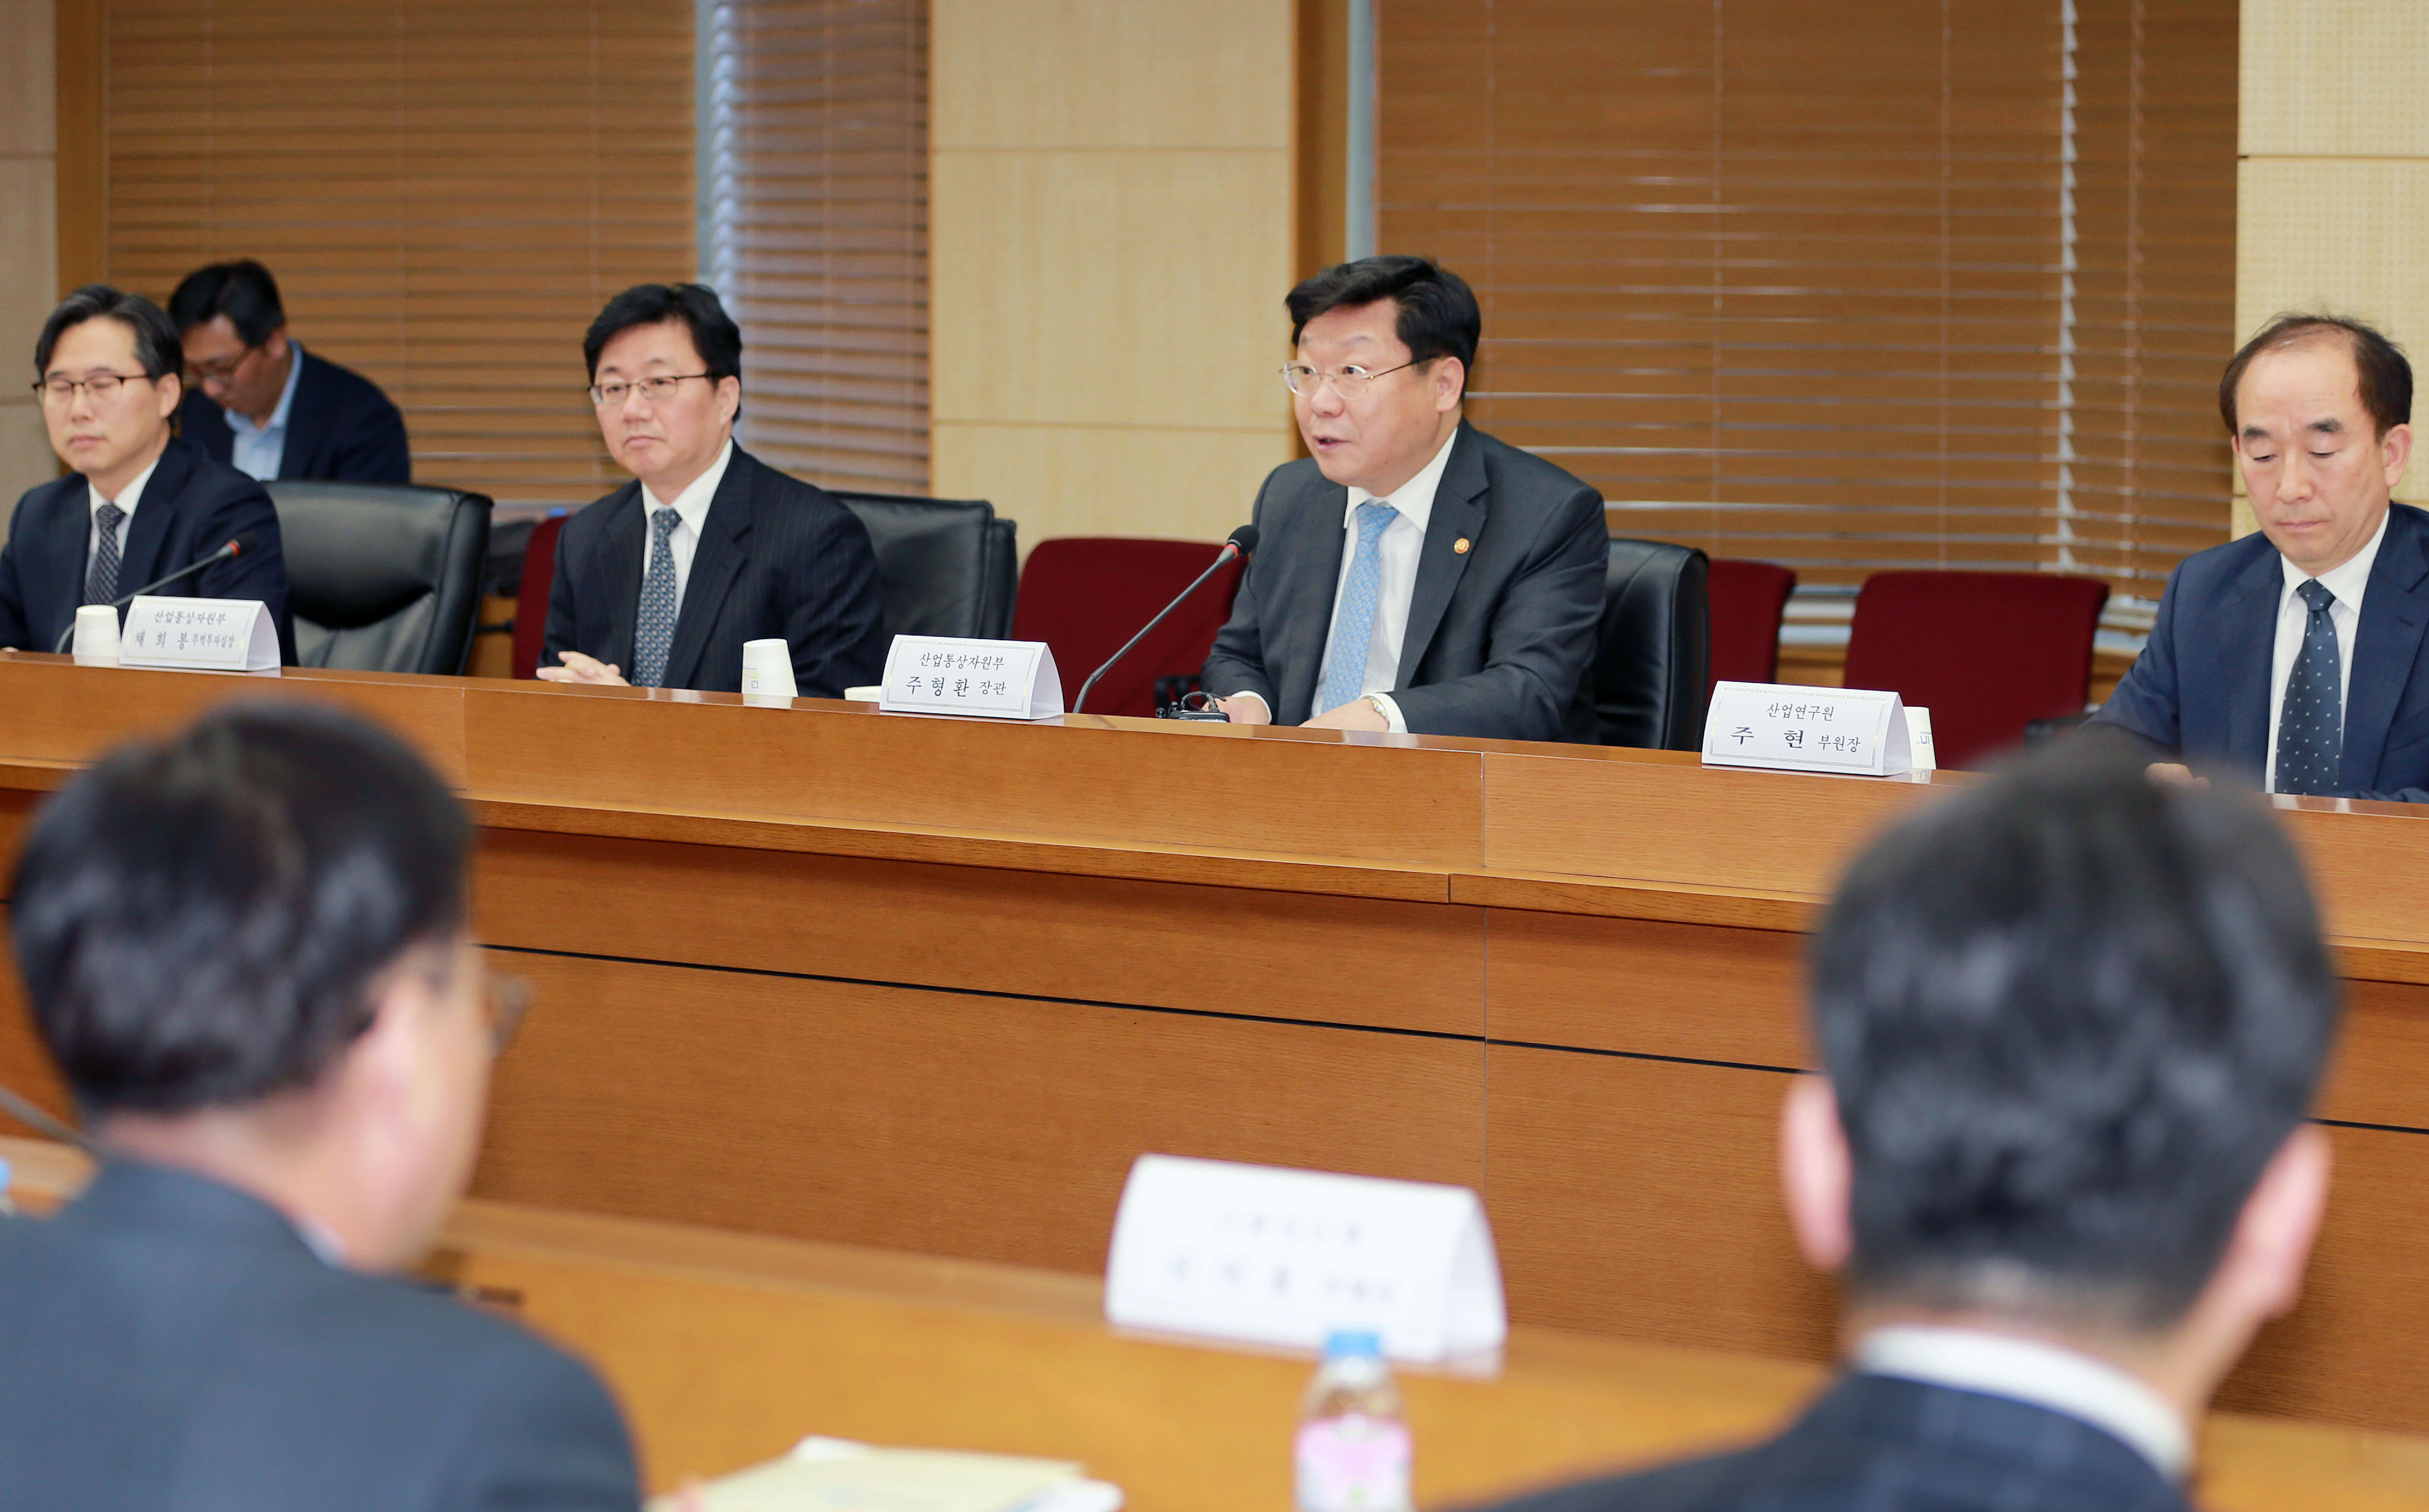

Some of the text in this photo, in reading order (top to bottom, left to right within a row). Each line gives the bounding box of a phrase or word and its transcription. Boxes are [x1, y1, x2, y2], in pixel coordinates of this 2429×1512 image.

[154, 610, 226, 625] 산업통상자원부
[919, 652, 1004, 671] 산업통상자원부
[978, 680, 1007, 695] 장관
[1766, 702, 1834, 722] 산업연구원
[1730, 726, 1862, 752] 주 현 부원장
